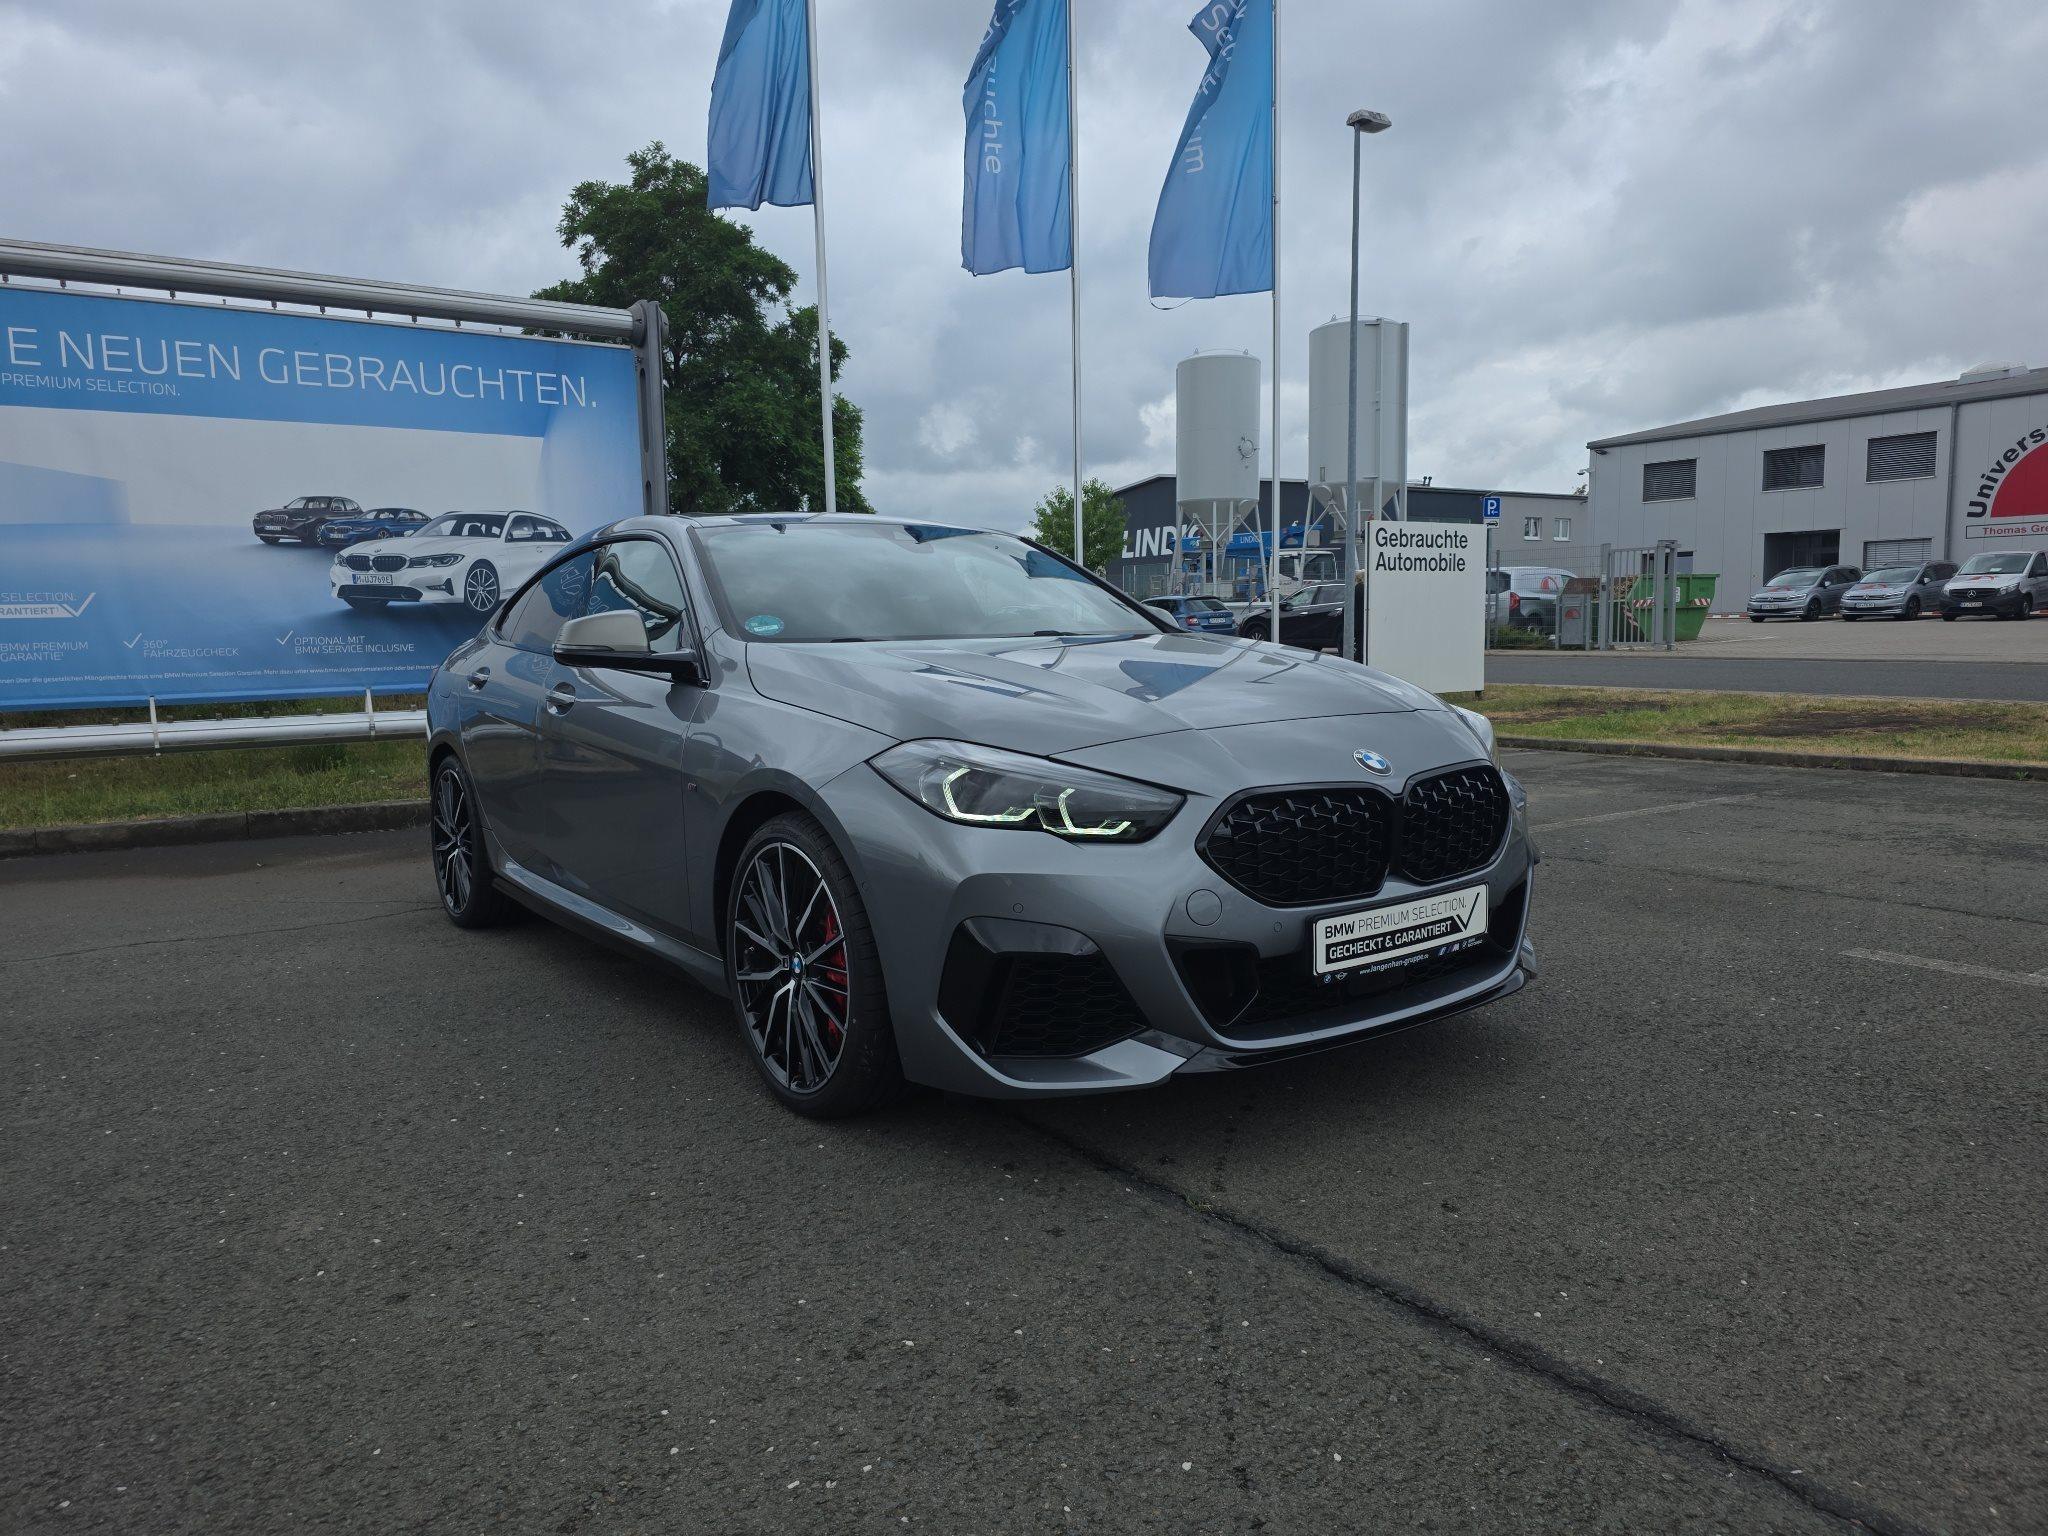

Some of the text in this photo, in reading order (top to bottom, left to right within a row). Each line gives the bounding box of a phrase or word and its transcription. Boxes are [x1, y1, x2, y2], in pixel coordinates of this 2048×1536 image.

[59, 330, 241, 381] NEUEN
[258, 347, 597, 408] GEBRAUCHTEN.
[1, 372, 181, 397] PREMIUM SELECTION.
[1966, 425, 2048, 518] Univers
[1487, 499, 1497, 515] P
[1375, 527, 1468, 549] Gebrauchte
[1982, 526, 2027, 535] Thomas
[1375, 551, 1466, 572] Automobile
[0, 641, 88, 652] BMW PREMIUM
[294, 635, 366, 646] OPTIONAL MIT
[295, 643, 415, 654] BMW SERVICE INCLUSIVE
[143, 647, 240, 658] FAHRZEUGCHECK
[1325, 896, 1467, 939] BMW PREMIUM SELECTION.
[1329, 936, 1384, 960] GECHECKT
[1385, 933, 1394, 947] &
[1394, 921, 1453, 945] GARANTIERT
